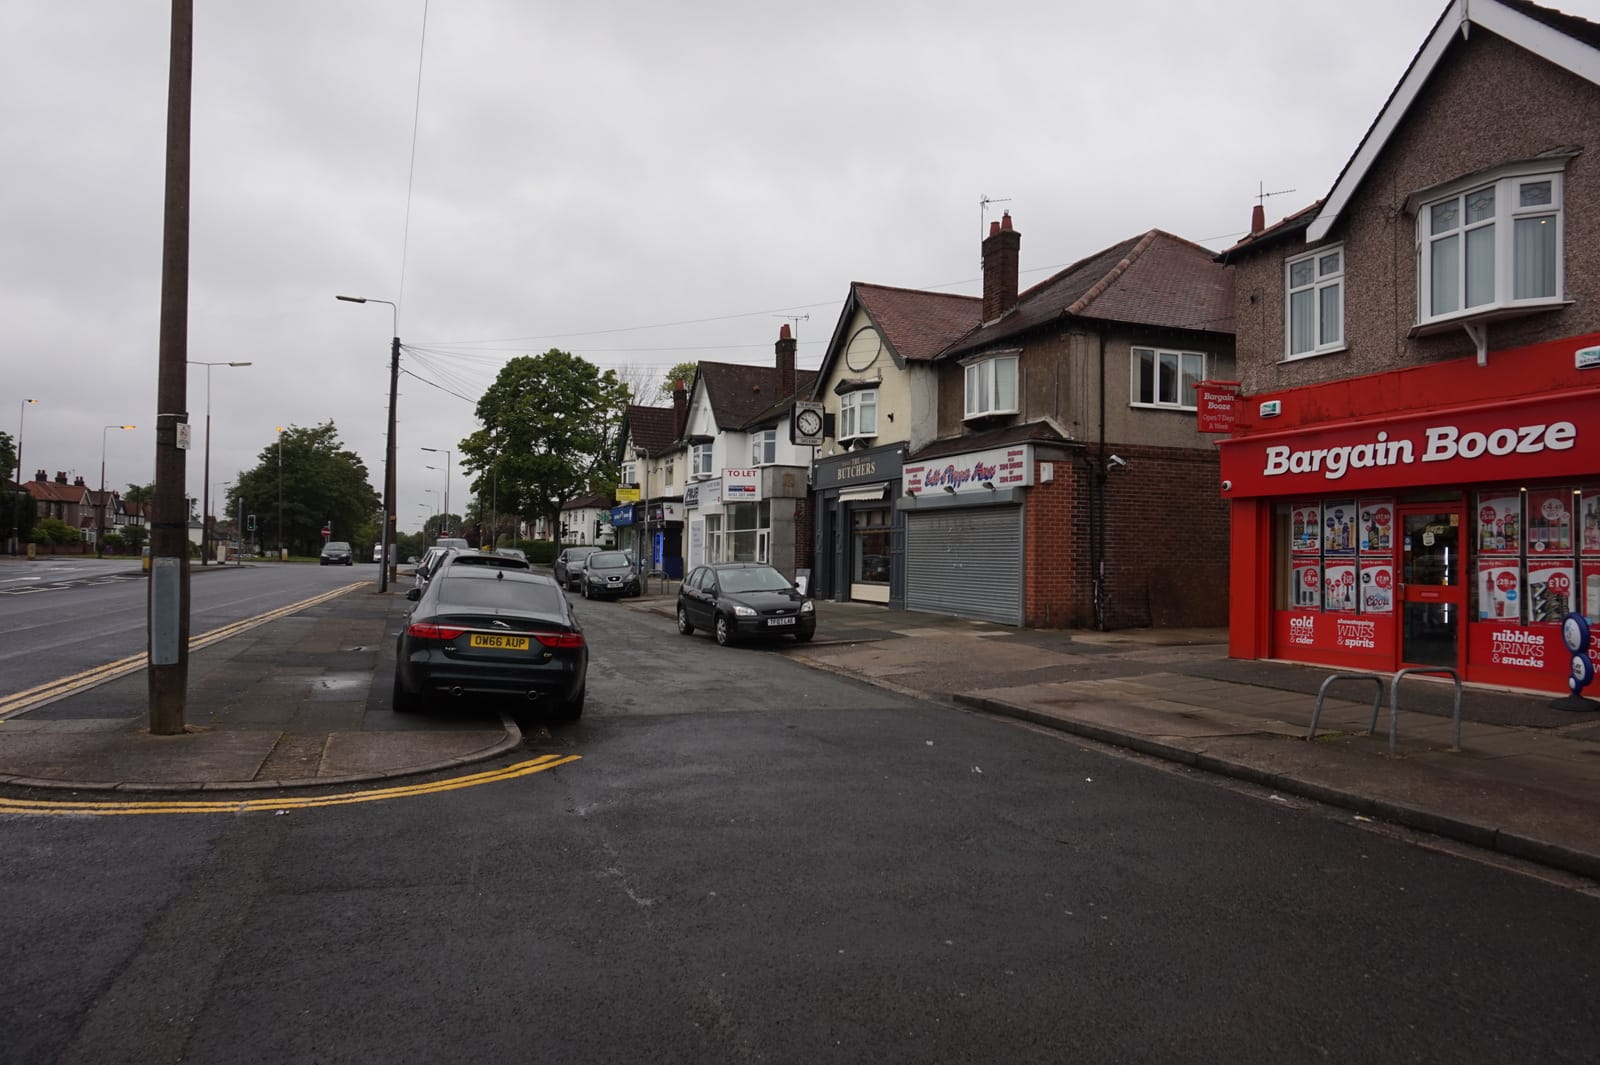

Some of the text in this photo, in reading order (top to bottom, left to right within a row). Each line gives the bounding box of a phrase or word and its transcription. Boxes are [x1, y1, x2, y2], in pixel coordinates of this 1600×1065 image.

[1203, 392, 1234, 402] Bargain
[1207, 401, 1231, 410] Booze
[1263, 421, 1577, 479] Bargain Booze
[837, 462, 876, 480] BUTCHERS
[1548, 577, 1569, 588] £10
[1290, 616, 1314, 627] cold
[1290, 627, 1314, 637] BEER
[1337, 625, 1375, 638] WINES
[1492, 630, 1544, 645] nibbles
[505, 638, 526, 648] AUP
[1295, 635, 1314, 644] cider
[1337, 635, 1375, 648] & spirits
[1492, 641, 1545, 657] DRINKS
[1492, 653, 1544, 668] & snacks
